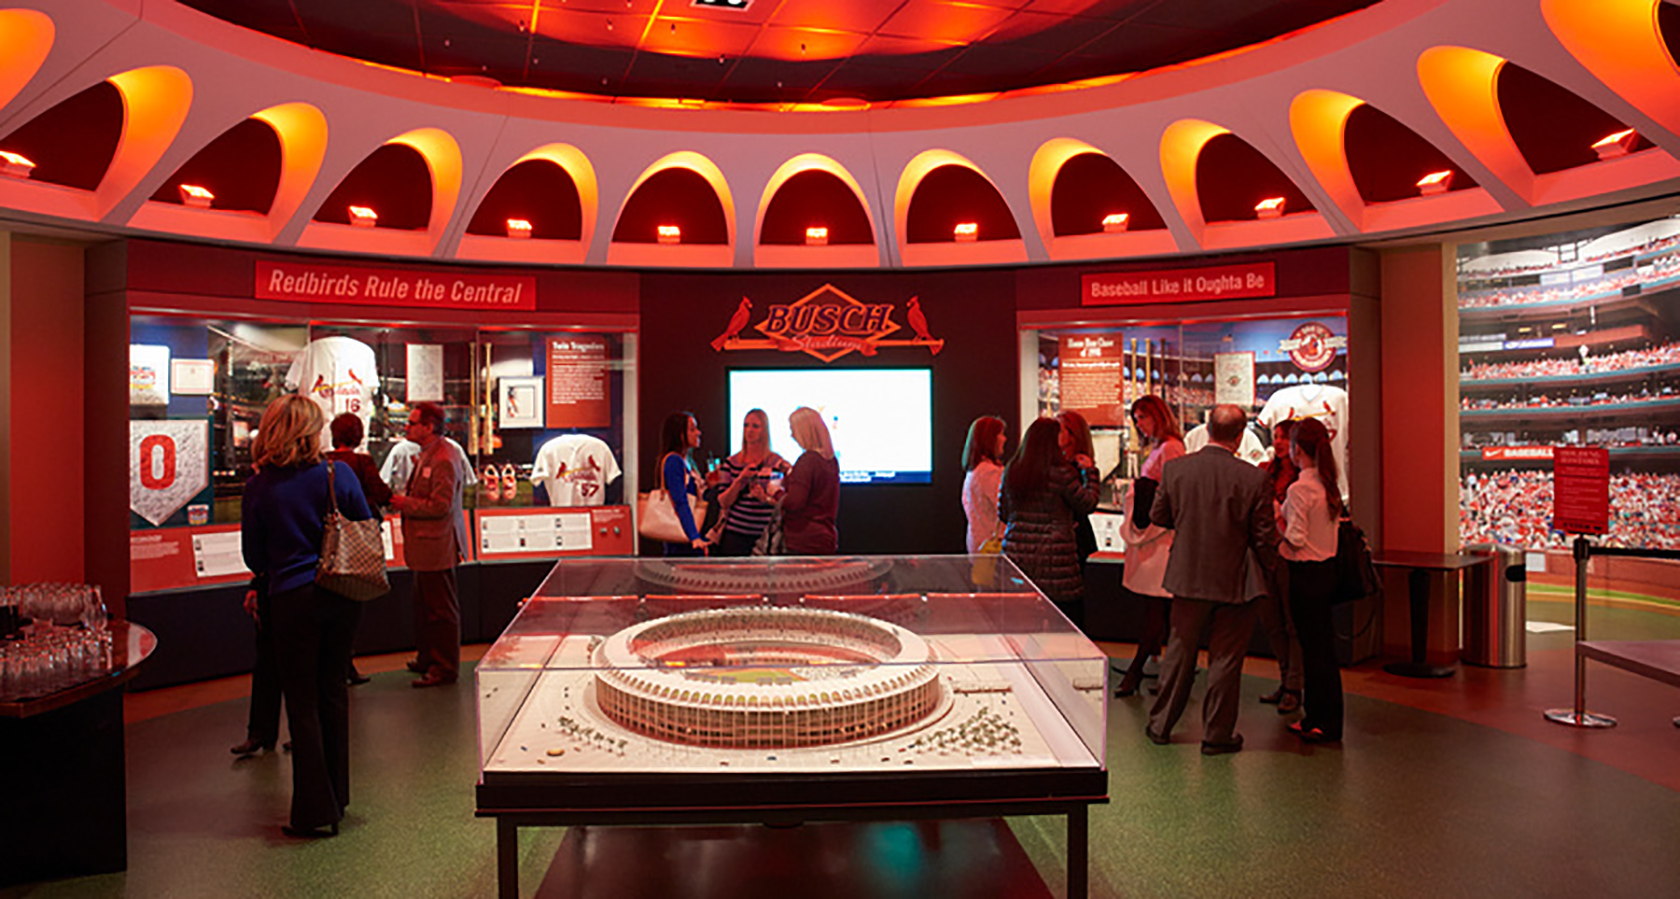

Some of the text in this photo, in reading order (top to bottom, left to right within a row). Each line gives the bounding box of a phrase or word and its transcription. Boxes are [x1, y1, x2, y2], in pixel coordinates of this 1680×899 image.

[268, 269, 522, 303] Redbirds Rule the Central
[1091, 272, 1265, 298] Baseball Like it Oughta Be
[766, 303, 895, 335] BUSCH
[784, 334, 863, 351] Stadium
[345, 398, 361, 413] 16
[140, 434, 176, 490] 0
[1504, 448, 1554, 457] BASEBALL
[581, 483, 600, 497] 57
